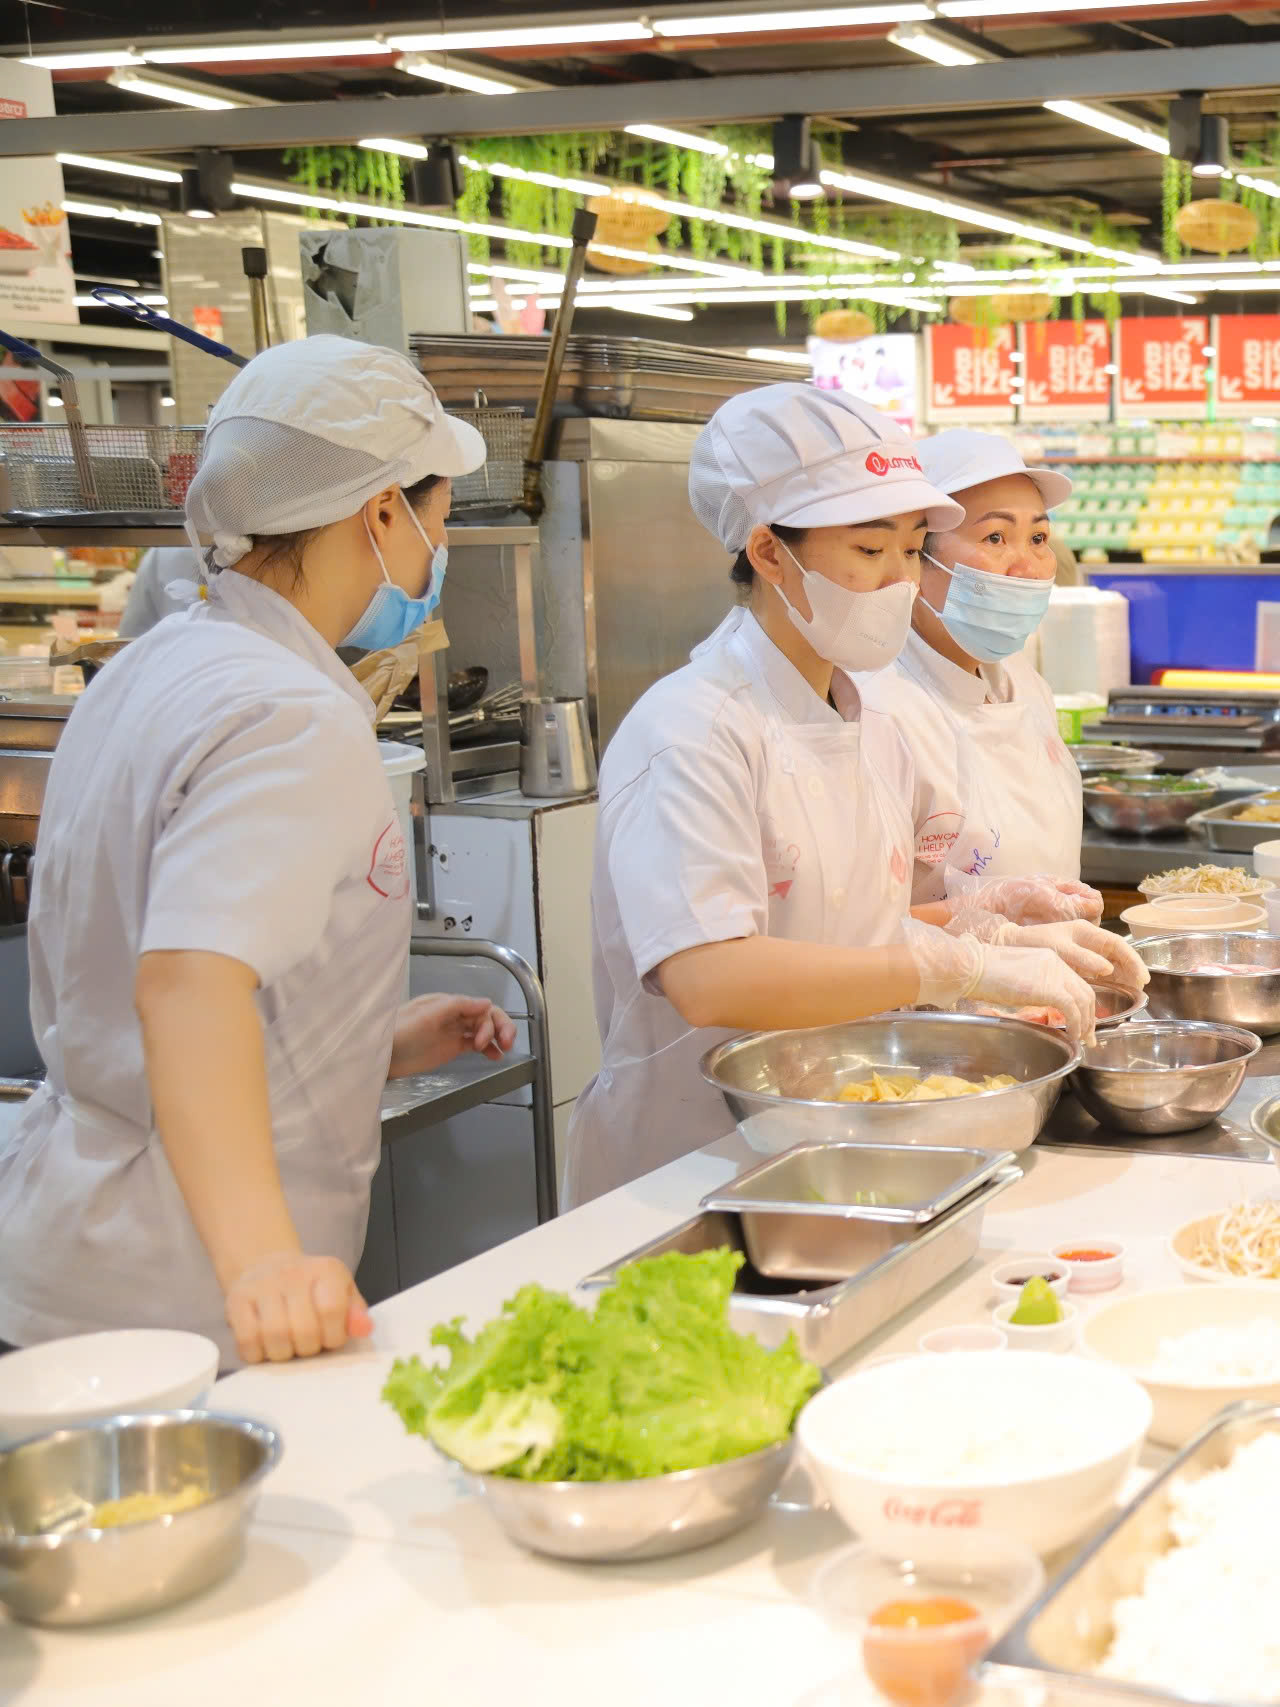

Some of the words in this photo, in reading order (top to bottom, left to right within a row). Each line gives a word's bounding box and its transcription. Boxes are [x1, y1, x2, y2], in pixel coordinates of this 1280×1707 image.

[955, 370, 1013, 395] SIZE
[1049, 368, 1107, 394] SIZE
[1144, 364, 1207, 390] SIZE
[921, 834, 943, 842] HOW
[923, 843, 944, 852] HELP
